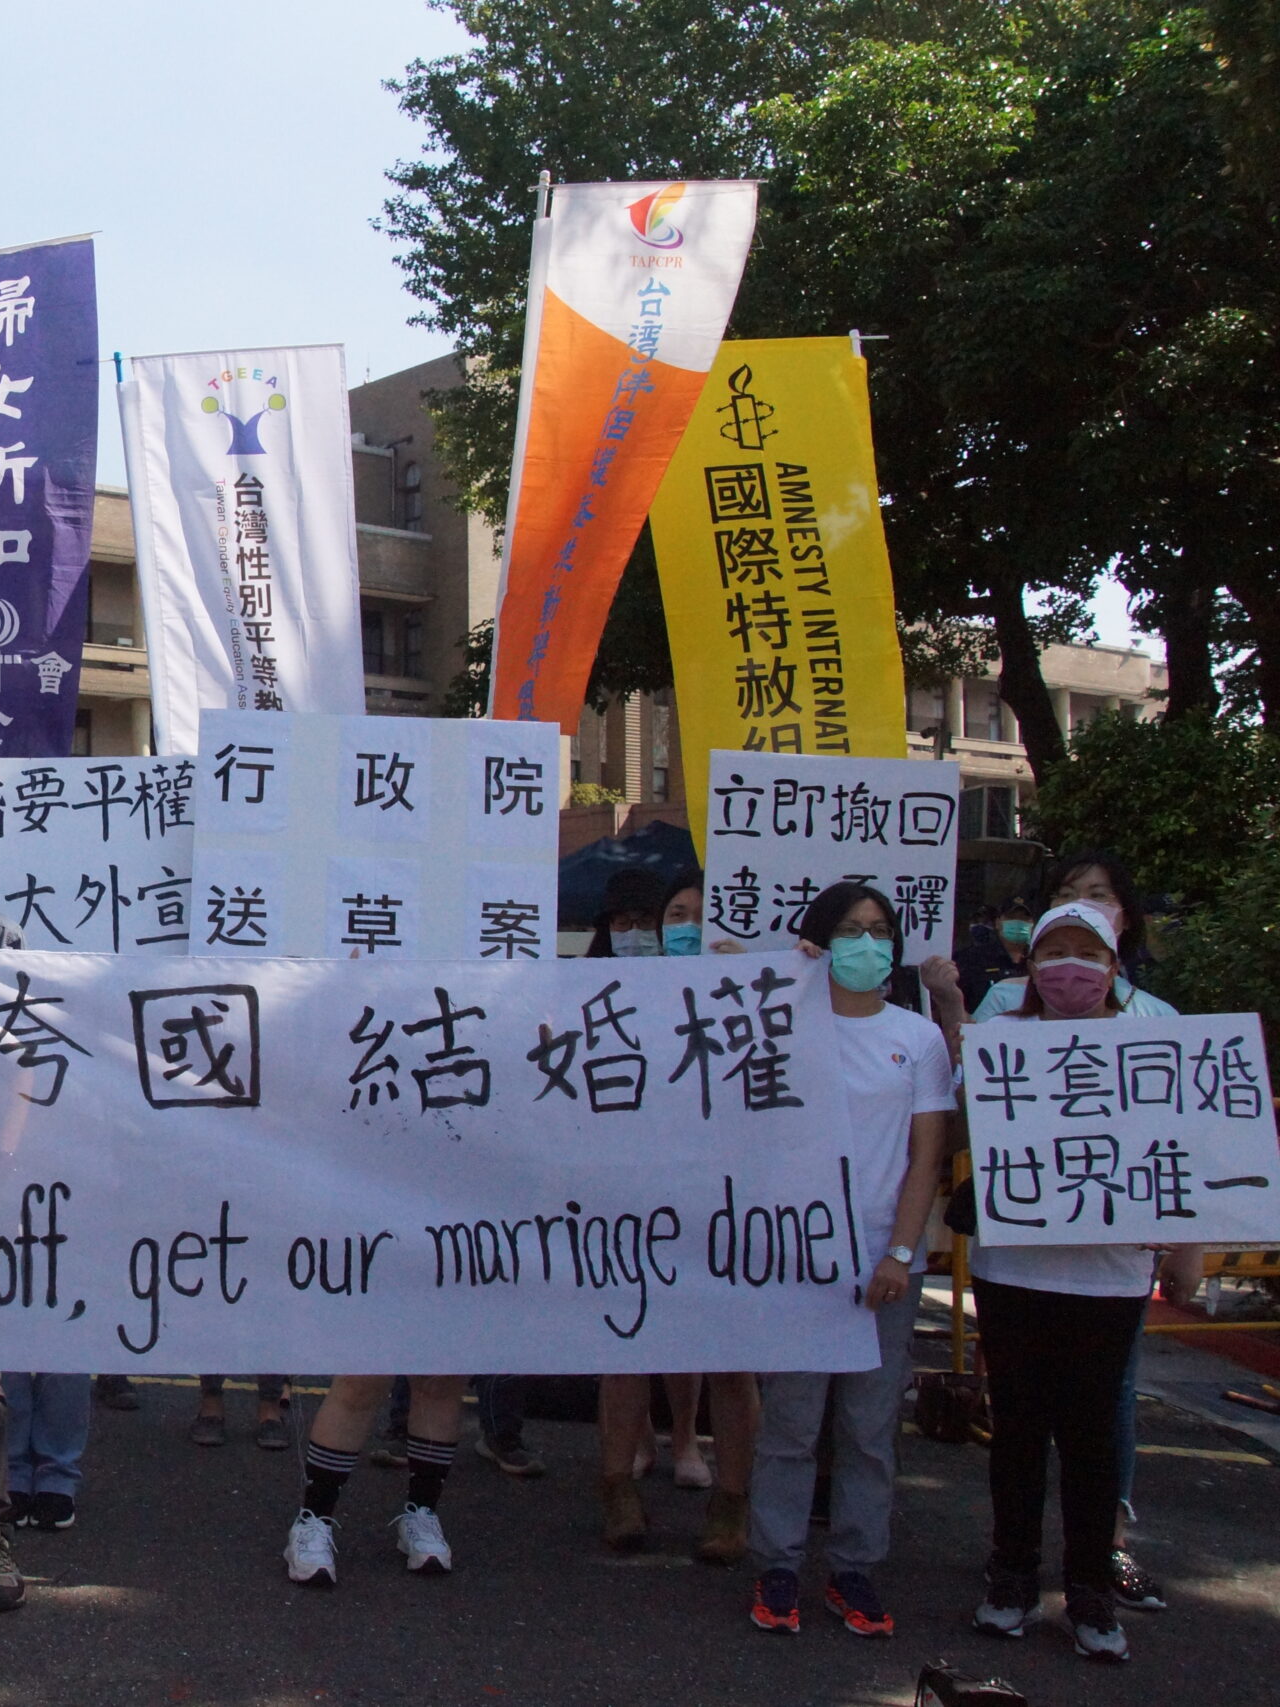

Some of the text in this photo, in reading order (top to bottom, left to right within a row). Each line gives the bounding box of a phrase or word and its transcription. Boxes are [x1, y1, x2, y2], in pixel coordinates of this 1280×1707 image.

[629, 255, 683, 268] TAPCPR
[208, 367, 278, 390] TGEEA
[216, 479, 248, 710] Taiwan Gender Equity Education Ass
[776, 462, 850, 754] AMNESTY INTERNAT
[214, 743, 543, 816] 行政院
[714, 773, 956, 846] 立即撤回
[207, 885, 540, 959] 送草案
[709, 865, 948, 941] 違法釋
[975, 1034, 1263, 1121] 半套同婚
[980, 1134, 1270, 1228] 世界唯一
[117, 1201, 248, 1354] get
[288, 1231, 394, 1296] our
[426, 1201, 680, 1339] marriage
[708, 1156, 865, 1305] done!
